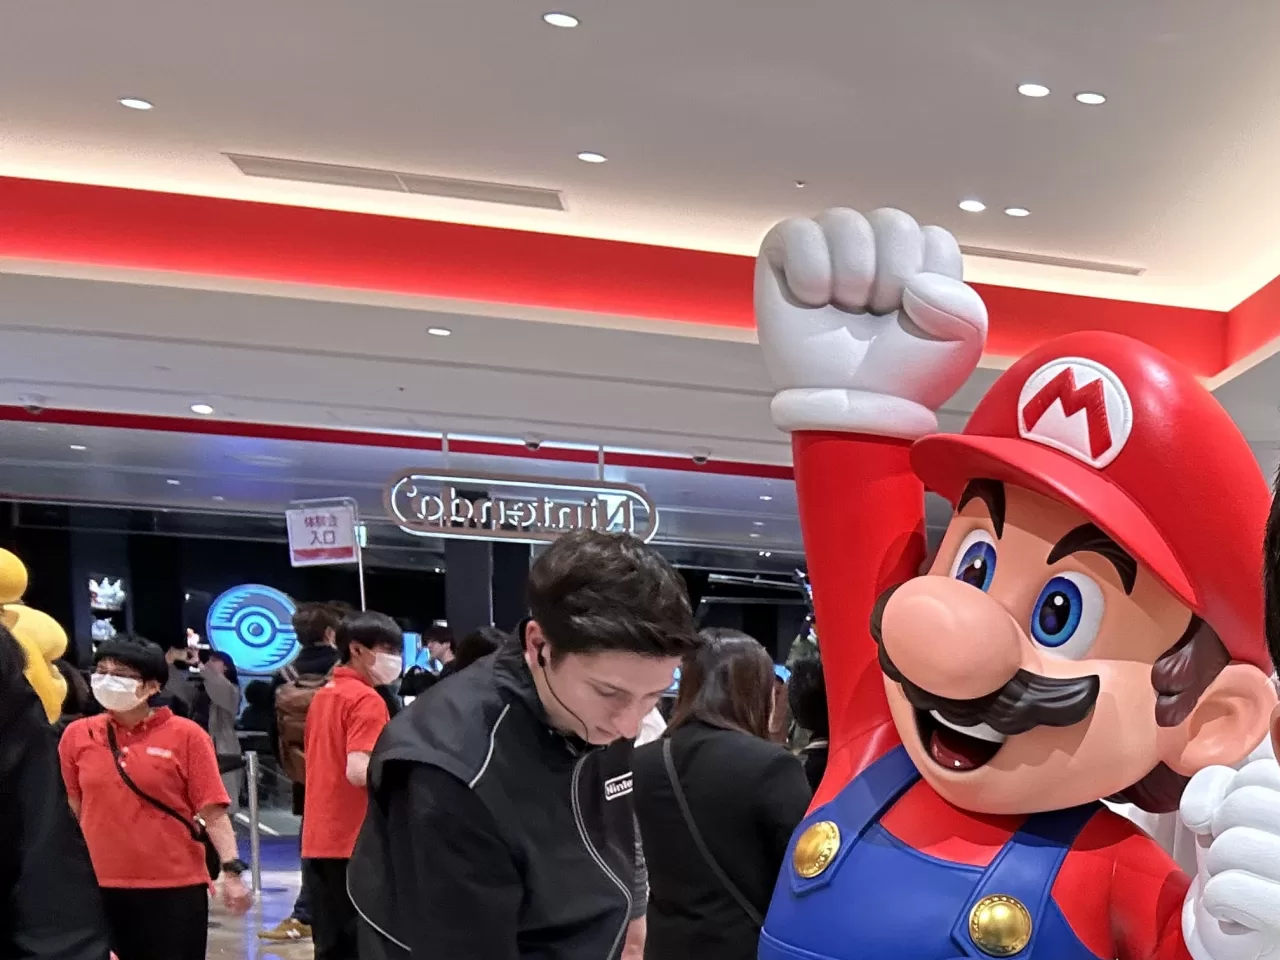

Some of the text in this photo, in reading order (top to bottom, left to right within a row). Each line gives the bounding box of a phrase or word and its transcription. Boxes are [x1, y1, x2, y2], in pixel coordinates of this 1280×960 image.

[1022, 366, 1113, 462] M
[310, 530, 336, 545] 入口
[606, 779, 633, 795] Ninte
